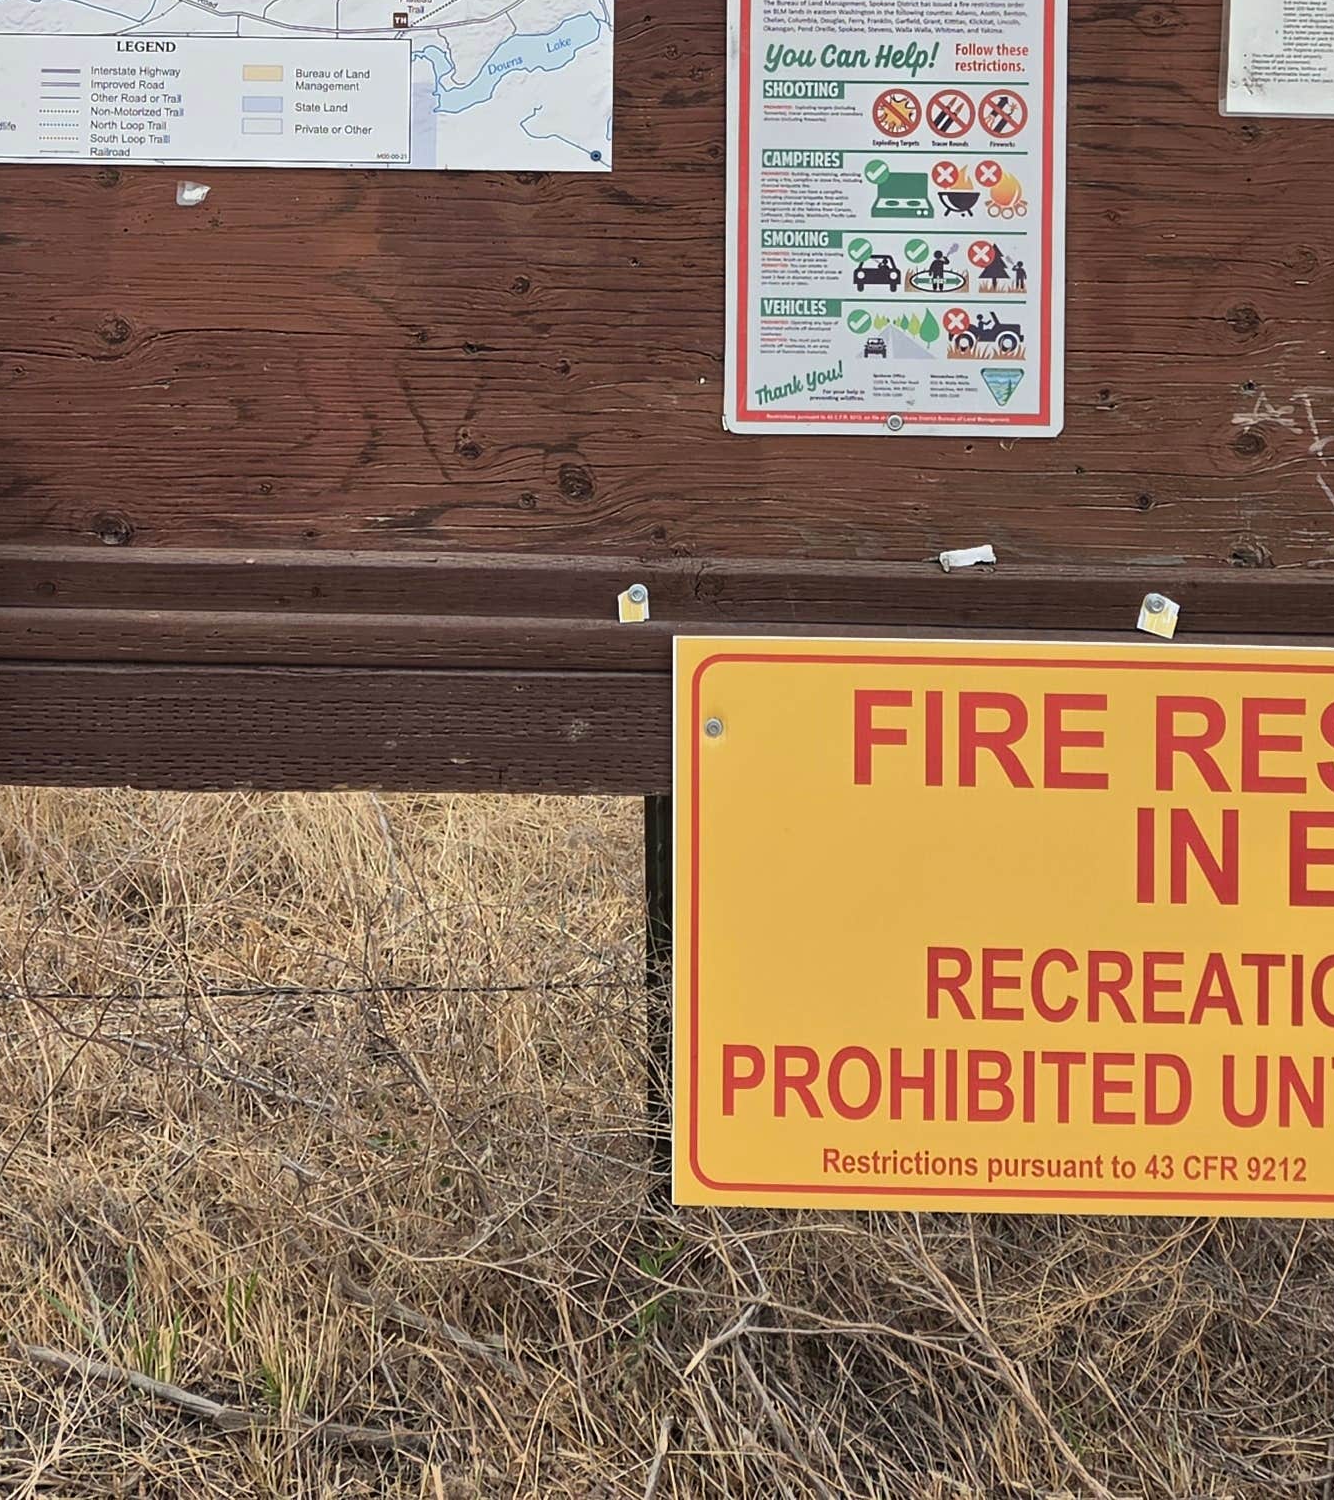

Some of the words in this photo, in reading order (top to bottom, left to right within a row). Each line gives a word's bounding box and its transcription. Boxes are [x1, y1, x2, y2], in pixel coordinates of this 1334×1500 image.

[117, 41, 176, 53] LEGEND
[955, 44, 993, 56] Follow
[997, 44, 1029, 56] these
[765, 42, 815, 72] You
[820, 44, 870, 68] Can
[875, 42, 939, 78] Help!
[955, 59, 1025, 72] restrictions.
[91, 80, 140, 91] Improved
[144, 81, 165, 90] Road
[765, 83, 839, 98] SHOOTING
[295, 103, 323, 113] State
[326, 103, 347, 113] Land
[295, 125, 329, 135] Private
[332, 127, 341, 135] or
[345, 125, 372, 136] Other
[764, 152, 840, 166] CAMPFIRES
[764, 231, 829, 246] SMOKING
[764, 300, 826, 315] VEHICLES
[852, 689, 1110, 790] FIRE
[1136, 808, 1239, 906] IN
[722, 1044, 1192, 1126] PROHIBITED
[823, 1149, 978, 1178] Restrictions
[988, 1155, 1103, 1182] pursuant
[1112, 1157, 1136, 1179] to
[1144, 1155, 1176, 1181] 43
[1183, 1155, 1238, 1181] CFR
[1247, 1157, 1307, 1183] 9212
